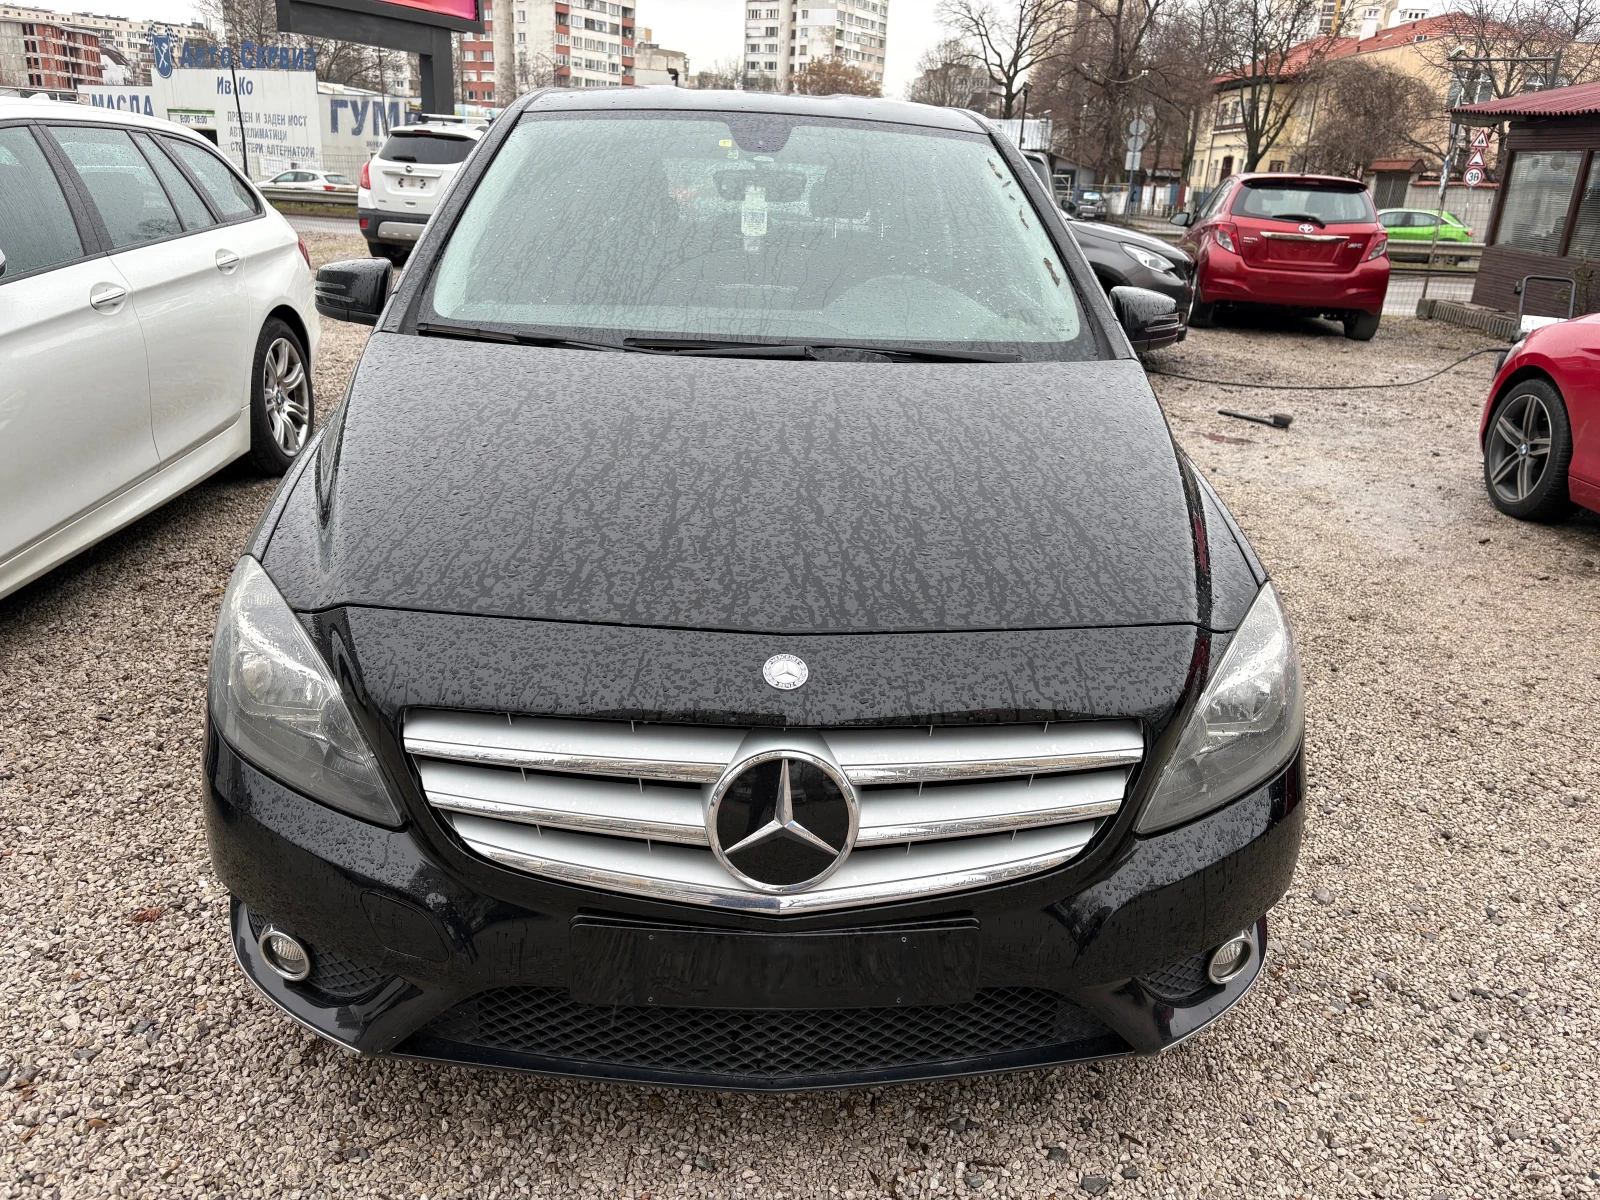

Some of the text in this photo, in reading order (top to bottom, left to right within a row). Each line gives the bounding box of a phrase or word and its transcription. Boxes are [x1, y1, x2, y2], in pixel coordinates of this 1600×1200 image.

[256, 112, 261, 124] И
[264, 113, 286, 127] ЗАДЕН
[288, 114, 307, 127] МОСТ
[330, 99, 419, 136] ГУМ
[267, 144, 316, 158] АЛТЕРНАТОРИ
